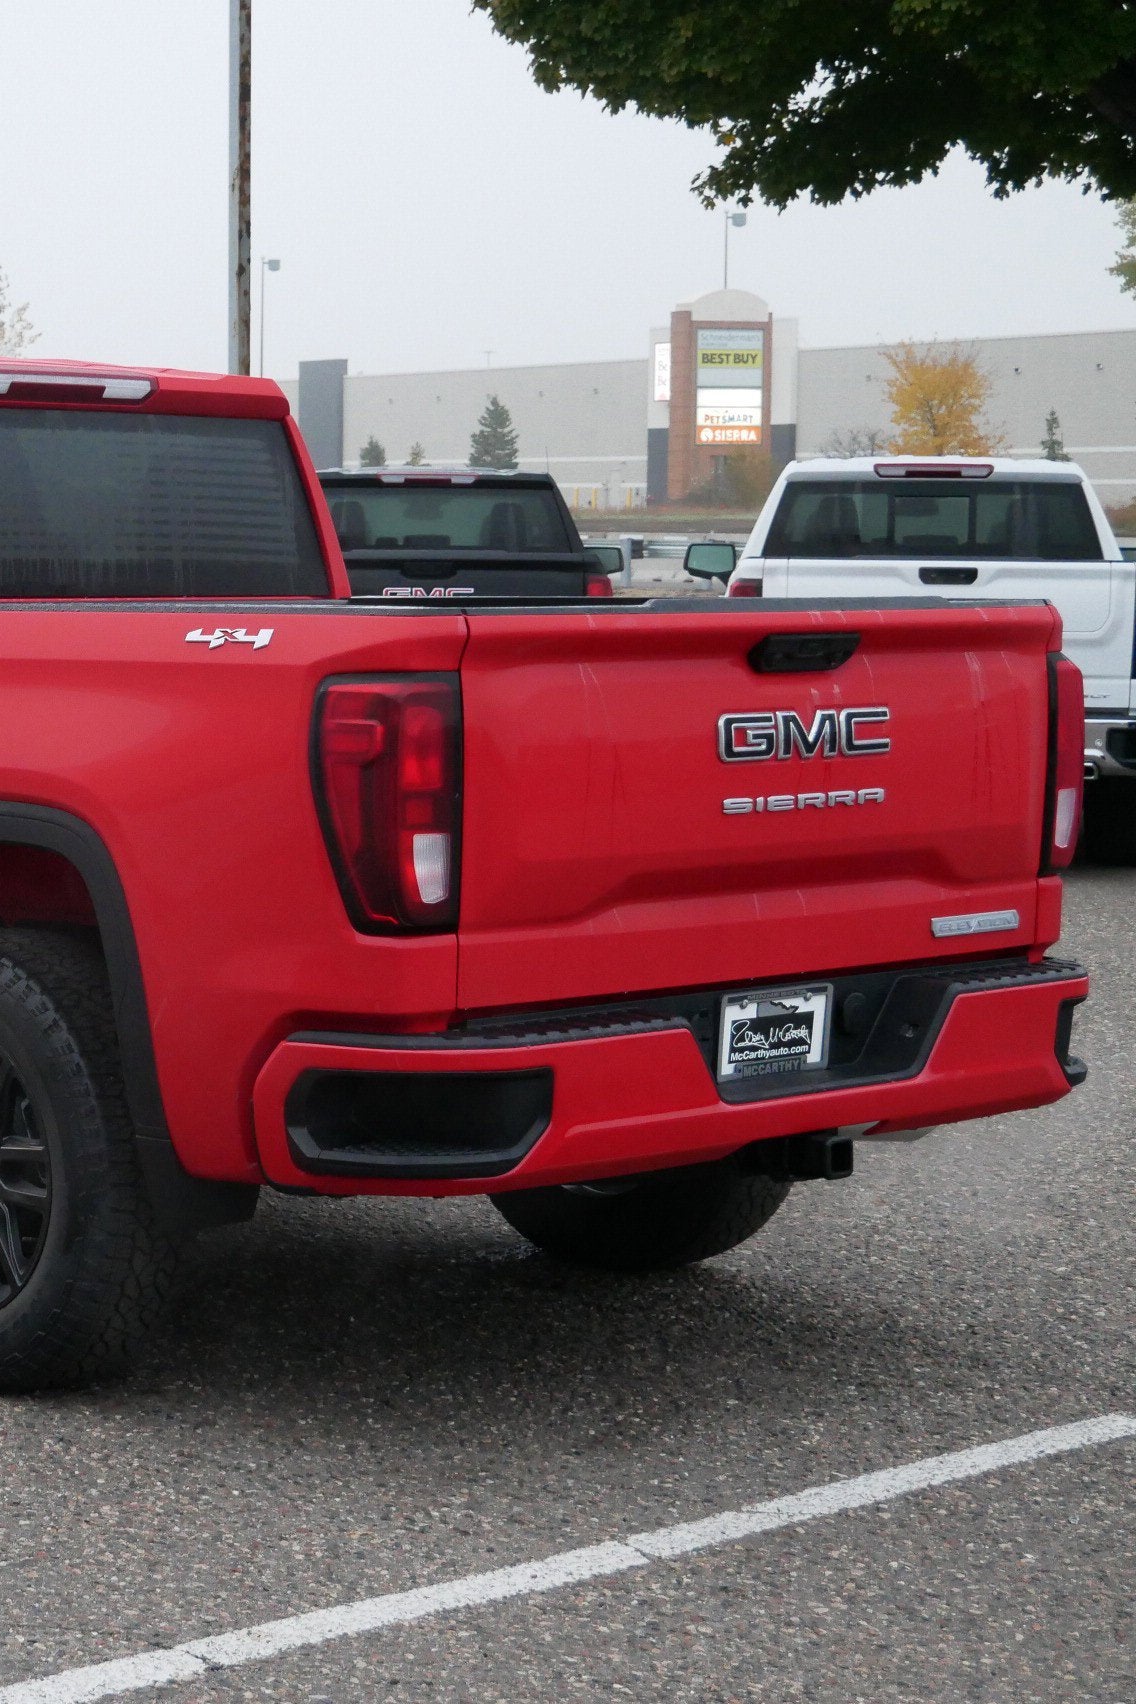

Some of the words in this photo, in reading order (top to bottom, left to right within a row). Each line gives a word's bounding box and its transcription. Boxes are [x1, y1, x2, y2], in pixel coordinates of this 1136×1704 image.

[701, 353, 731, 364] BEST
[733, 353, 758, 364] BUY
[713, 430, 757, 441] SIERRA
[718, 707, 891, 763] GMC
[722, 788, 885, 815] SIERRA
[730, 1044, 809, 1062] McCarthyauto.com
[744, 1060, 800, 1077] MCCARTHY
